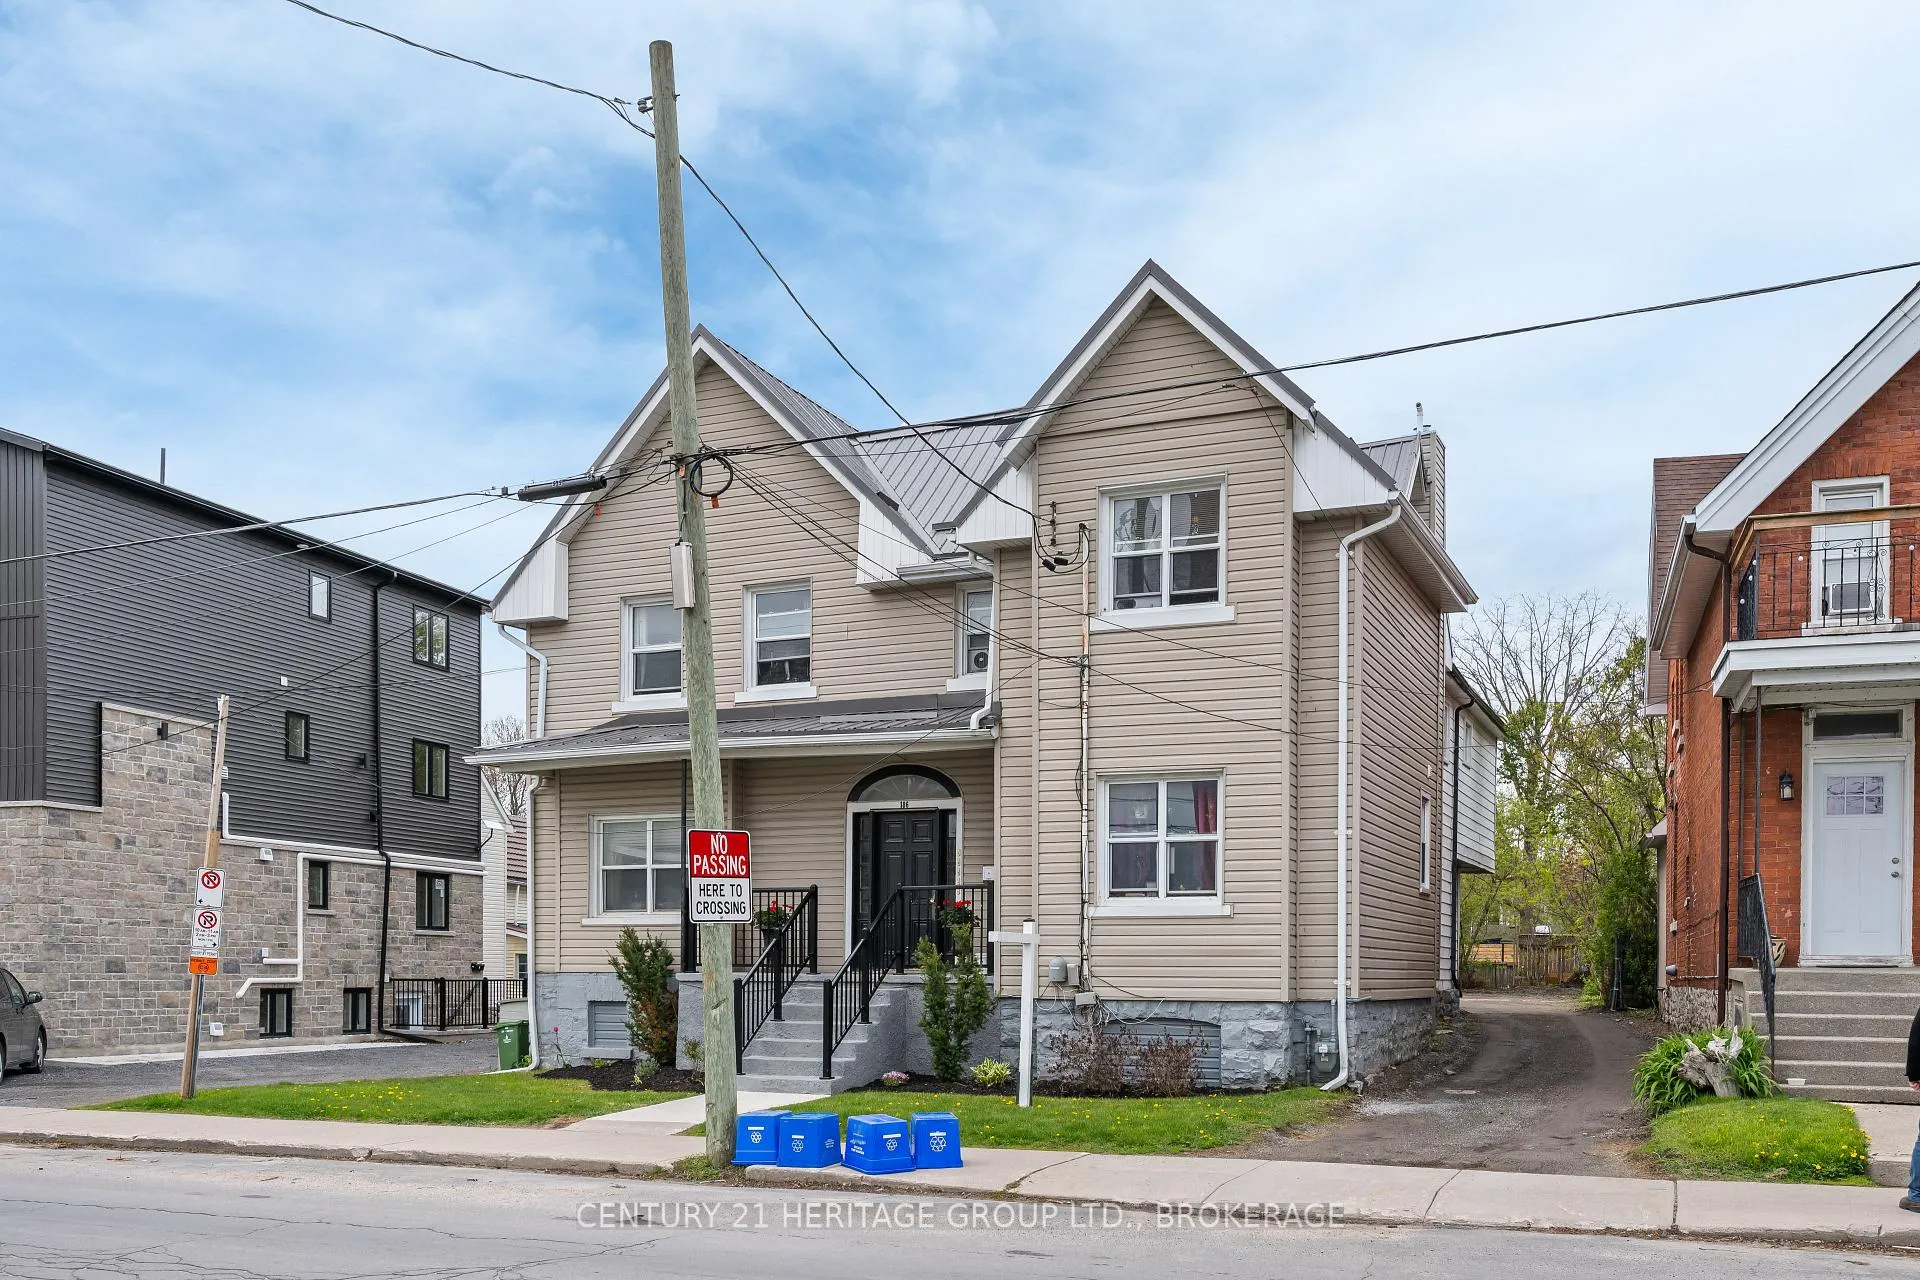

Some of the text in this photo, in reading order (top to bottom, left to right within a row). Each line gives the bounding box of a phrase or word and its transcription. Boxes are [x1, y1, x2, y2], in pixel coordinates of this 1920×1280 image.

[710, 834, 728, 854] NO
[693, 854, 747, 876] PASSING
[699, 883, 743, 897] HERE TO
[696, 901, 746, 915] CROSSING
